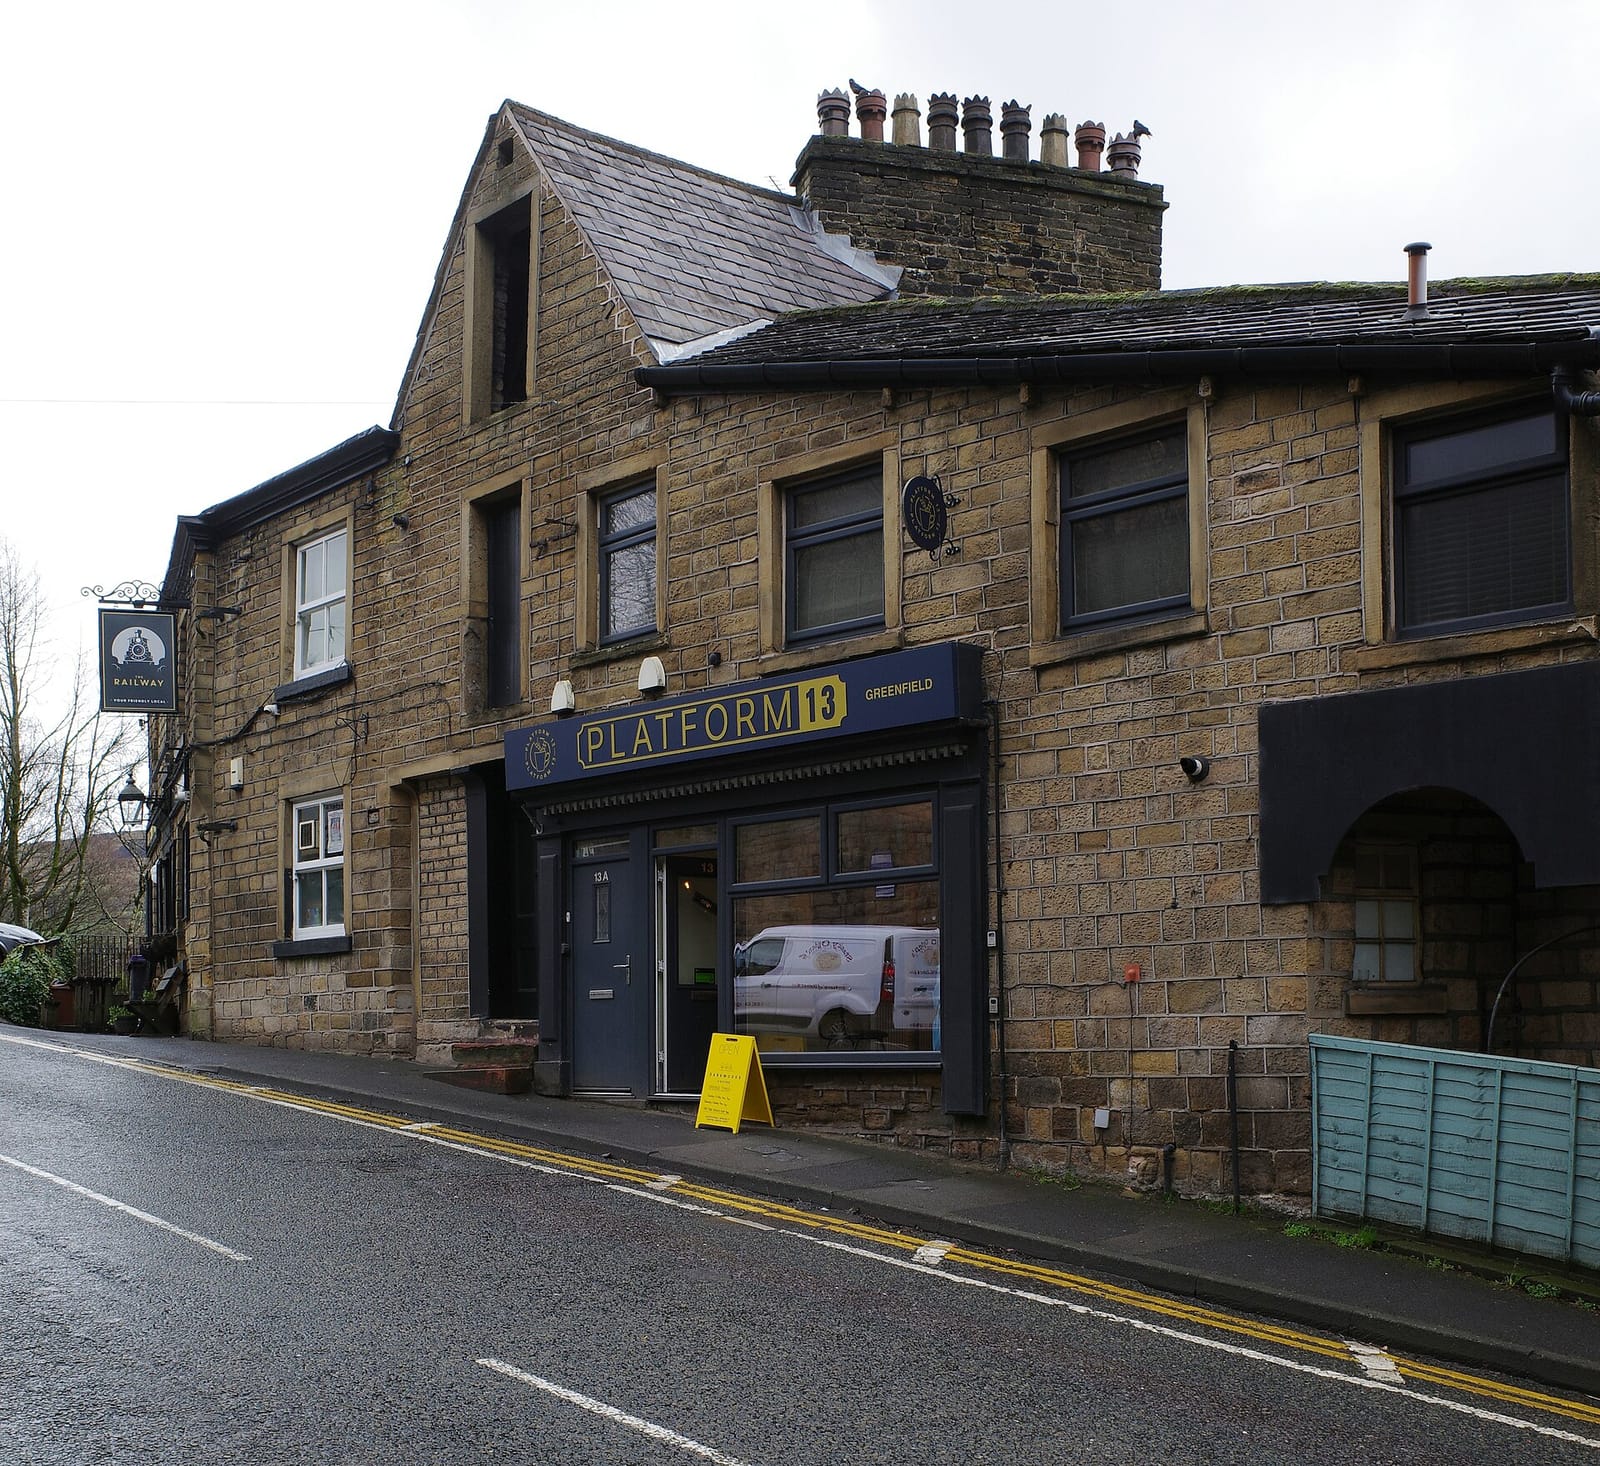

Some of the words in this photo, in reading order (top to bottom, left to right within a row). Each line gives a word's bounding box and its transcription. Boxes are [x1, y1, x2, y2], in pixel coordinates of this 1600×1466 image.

[114, 679, 164, 687] RAILWAY
[865, 678, 933, 700] GREENFIELD
[587, 690, 792, 763] PLATFORM
[805, 684, 836, 723] 13
[700, 862, 714, 873] 13
